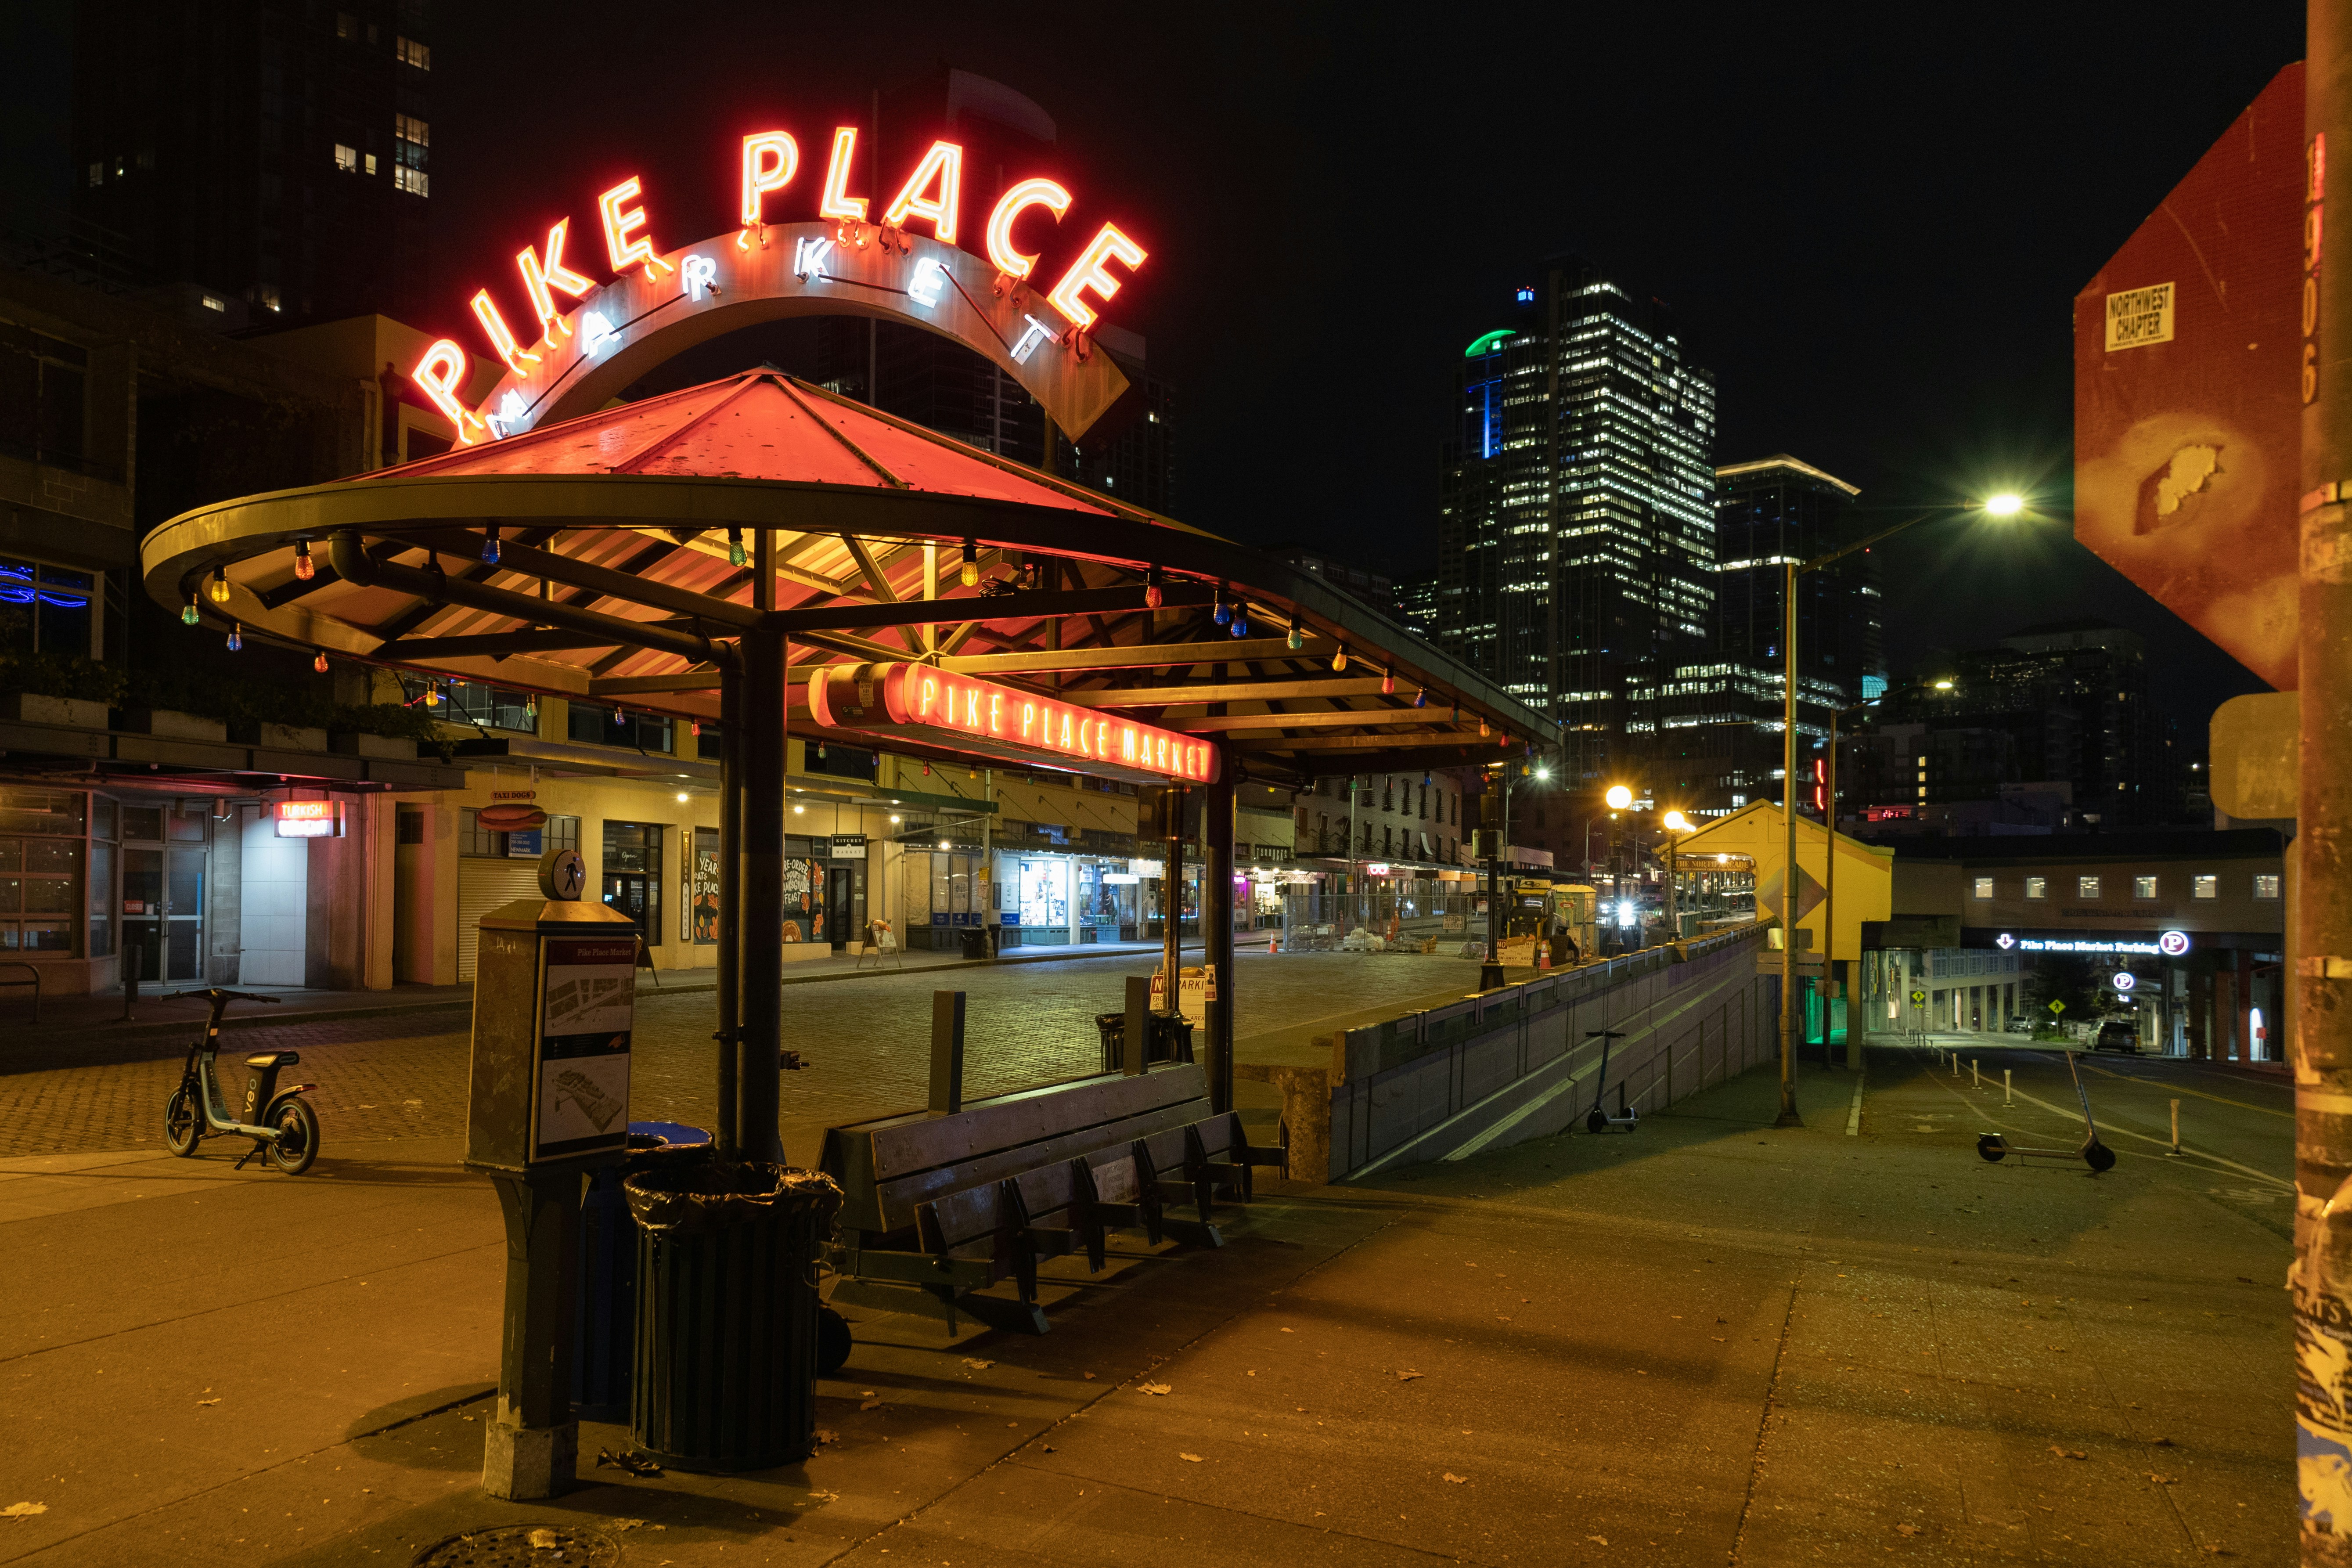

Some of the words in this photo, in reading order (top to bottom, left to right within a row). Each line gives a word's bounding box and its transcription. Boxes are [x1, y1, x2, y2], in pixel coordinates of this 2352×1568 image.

[412, 174, 653, 424] PIKE
[743, 126, 1148, 328] PLACE
[2109, 286, 2169, 320] NORTHWEST
[2116, 312, 2160, 341] CHAPTER
[485, 237, 1059, 440] MARKET
[920, 678, 1000, 732] PIKE
[1023, 703, 1106, 756] PLACE
[1122, 727, 1207, 776] MARKET
[282, 804, 323, 817] TURKISH
[622, 851, 637, 862] Open
[784, 859, 808, 875] RE-ORDER
[1692, 860, 1718, 869] NORTH
[697, 872, 704, 880] AT
[703, 881, 718, 896] PLAC
[783, 880, 810, 893] ANKSGIVING
[784, 892, 801, 905] FEAST
[2020, 940, 2044, 950] Pike
[2044, 941, 2074, 950] Place
[2075, 941, 2114, 952] Market
[2115, 942, 2160, 955] Parking
[2166, 935, 2182, 950] P
[1154, 979, 1163, 991] N
[1180, 980, 1204, 990] ARKI
[2120, 976, 2129, 987] P
[245, 1078, 256, 1113] veo
